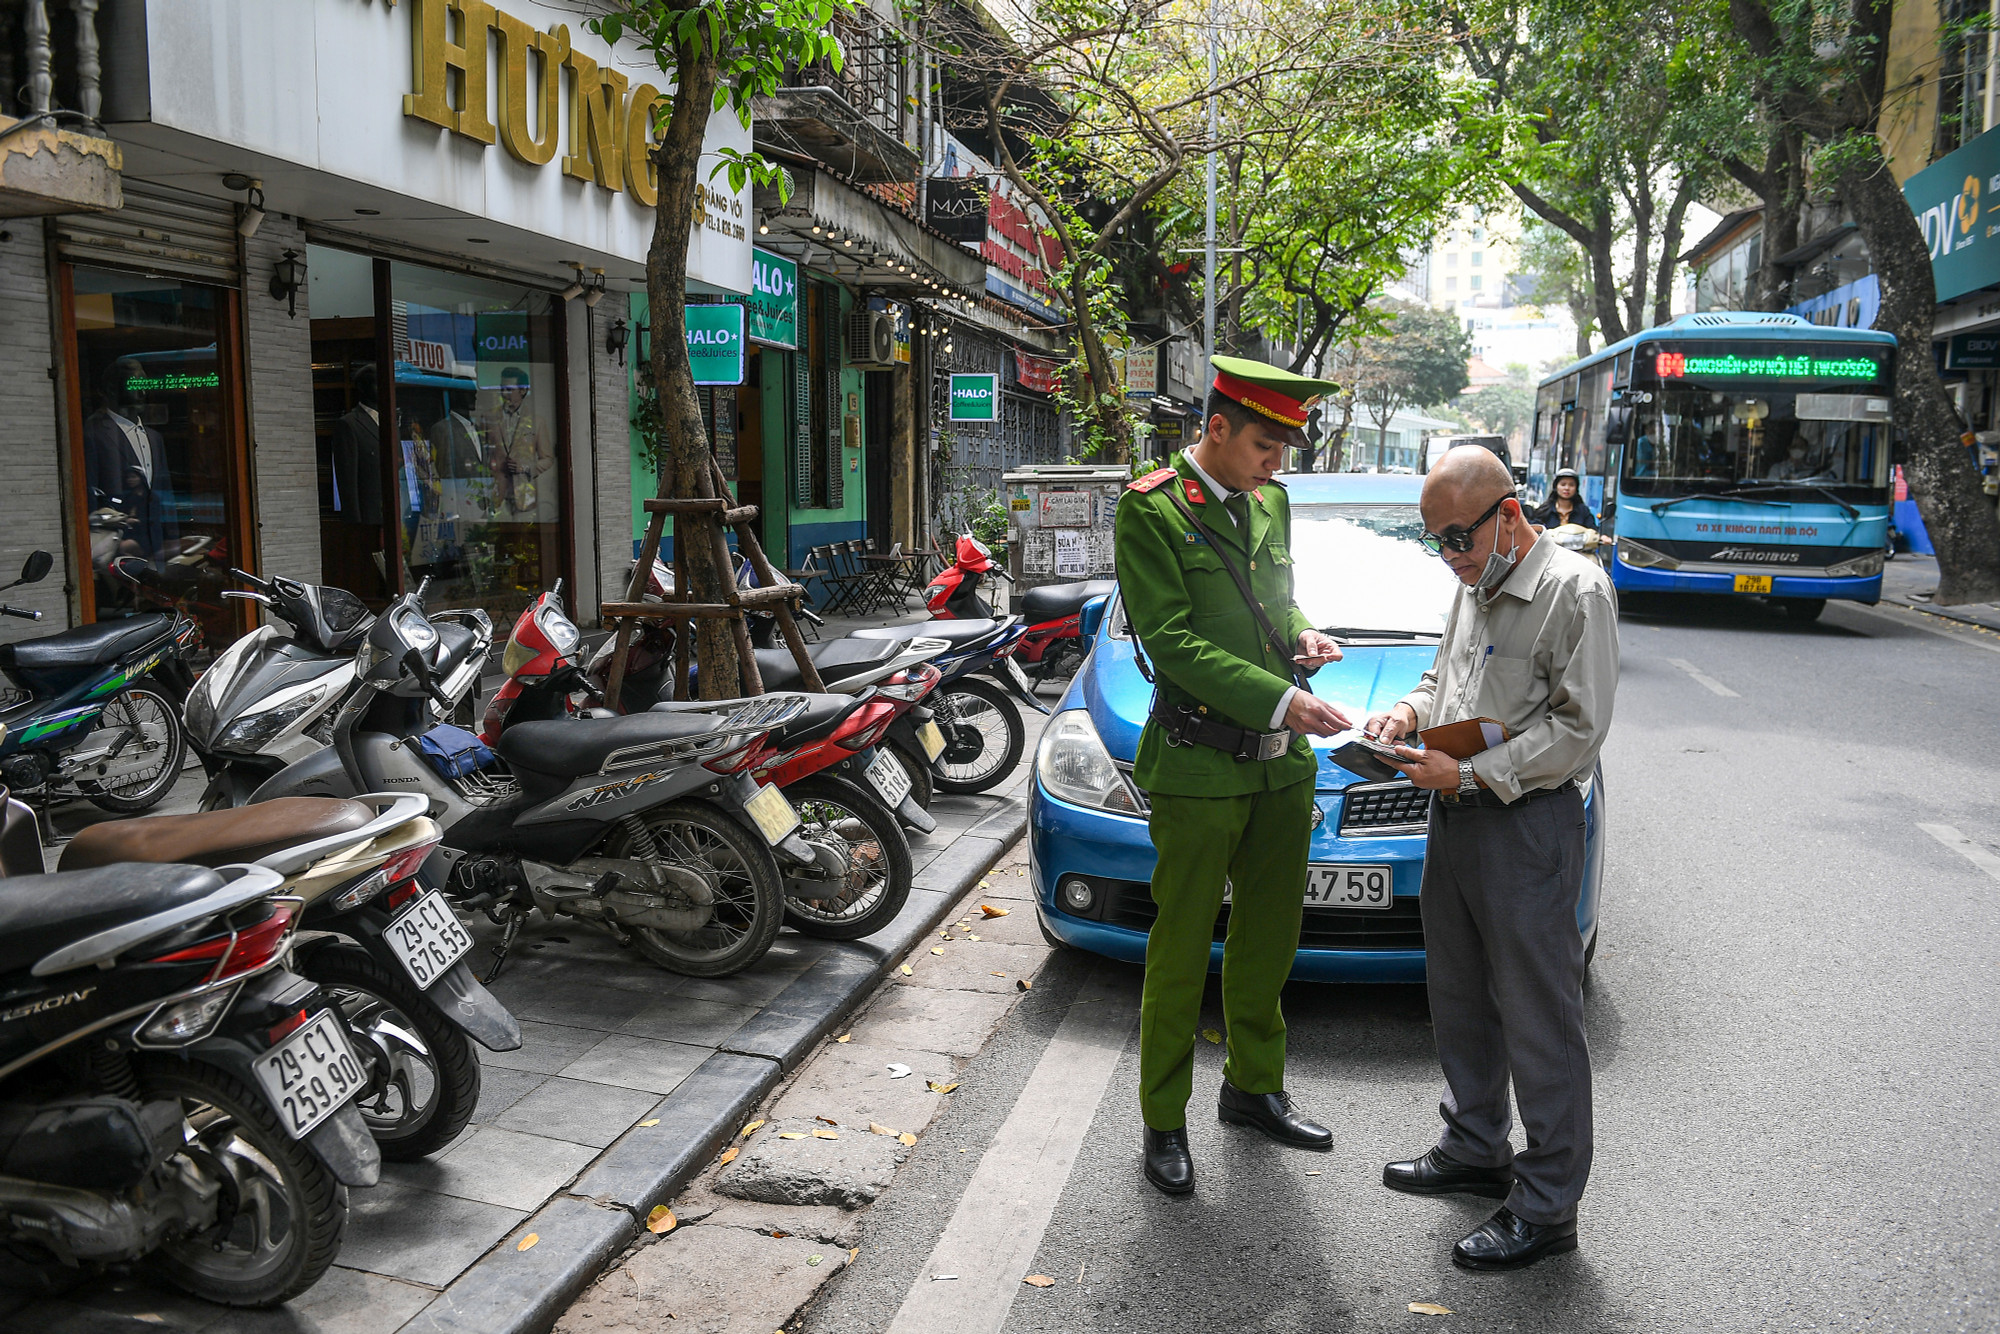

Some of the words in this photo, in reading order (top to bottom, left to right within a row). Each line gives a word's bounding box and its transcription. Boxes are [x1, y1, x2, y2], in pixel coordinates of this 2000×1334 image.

[705, 186, 728, 213] HÀNG
[730, 199, 743, 219] VÔI
[1914, 193, 1962, 261] IDV
[752, 260, 783, 297] ALO
[688, 348, 737, 358] fee&Juices
[1967, 340, 1998, 351] BIDV
[1684, 358, 1715, 374] LONG
[1715, 354, 1741, 374] BIÊN
[952, 400, 993, 409] Coffee&Juices
[957, 388, 988, 399] HALO
[1711, 524, 1722, 532] XE
[1725, 523, 1756, 534] KHÁCH
[1759, 527, 1781, 535] NAM
[1784, 526, 1796, 536] HÀ
[1799, 526, 1817, 538] NỘI
[1710, 546, 1800, 562] HANOIBUS
[124, 651, 160, 681] Wave
[382, 776, 421, 785] HONDA
[869, 754, 895, 787] 29-V7
[884, 770, 908, 804] 5184
[1303, 871, 1384, 903] 47.59
[395, 900, 446, 952] 29-C1
[409, 921, 467, 982] 676.55
[0, 986, 97, 1022] ISION
[270, 1023, 336, 1091] 29-C1
[283, 1053, 358, 1131] 259.90
